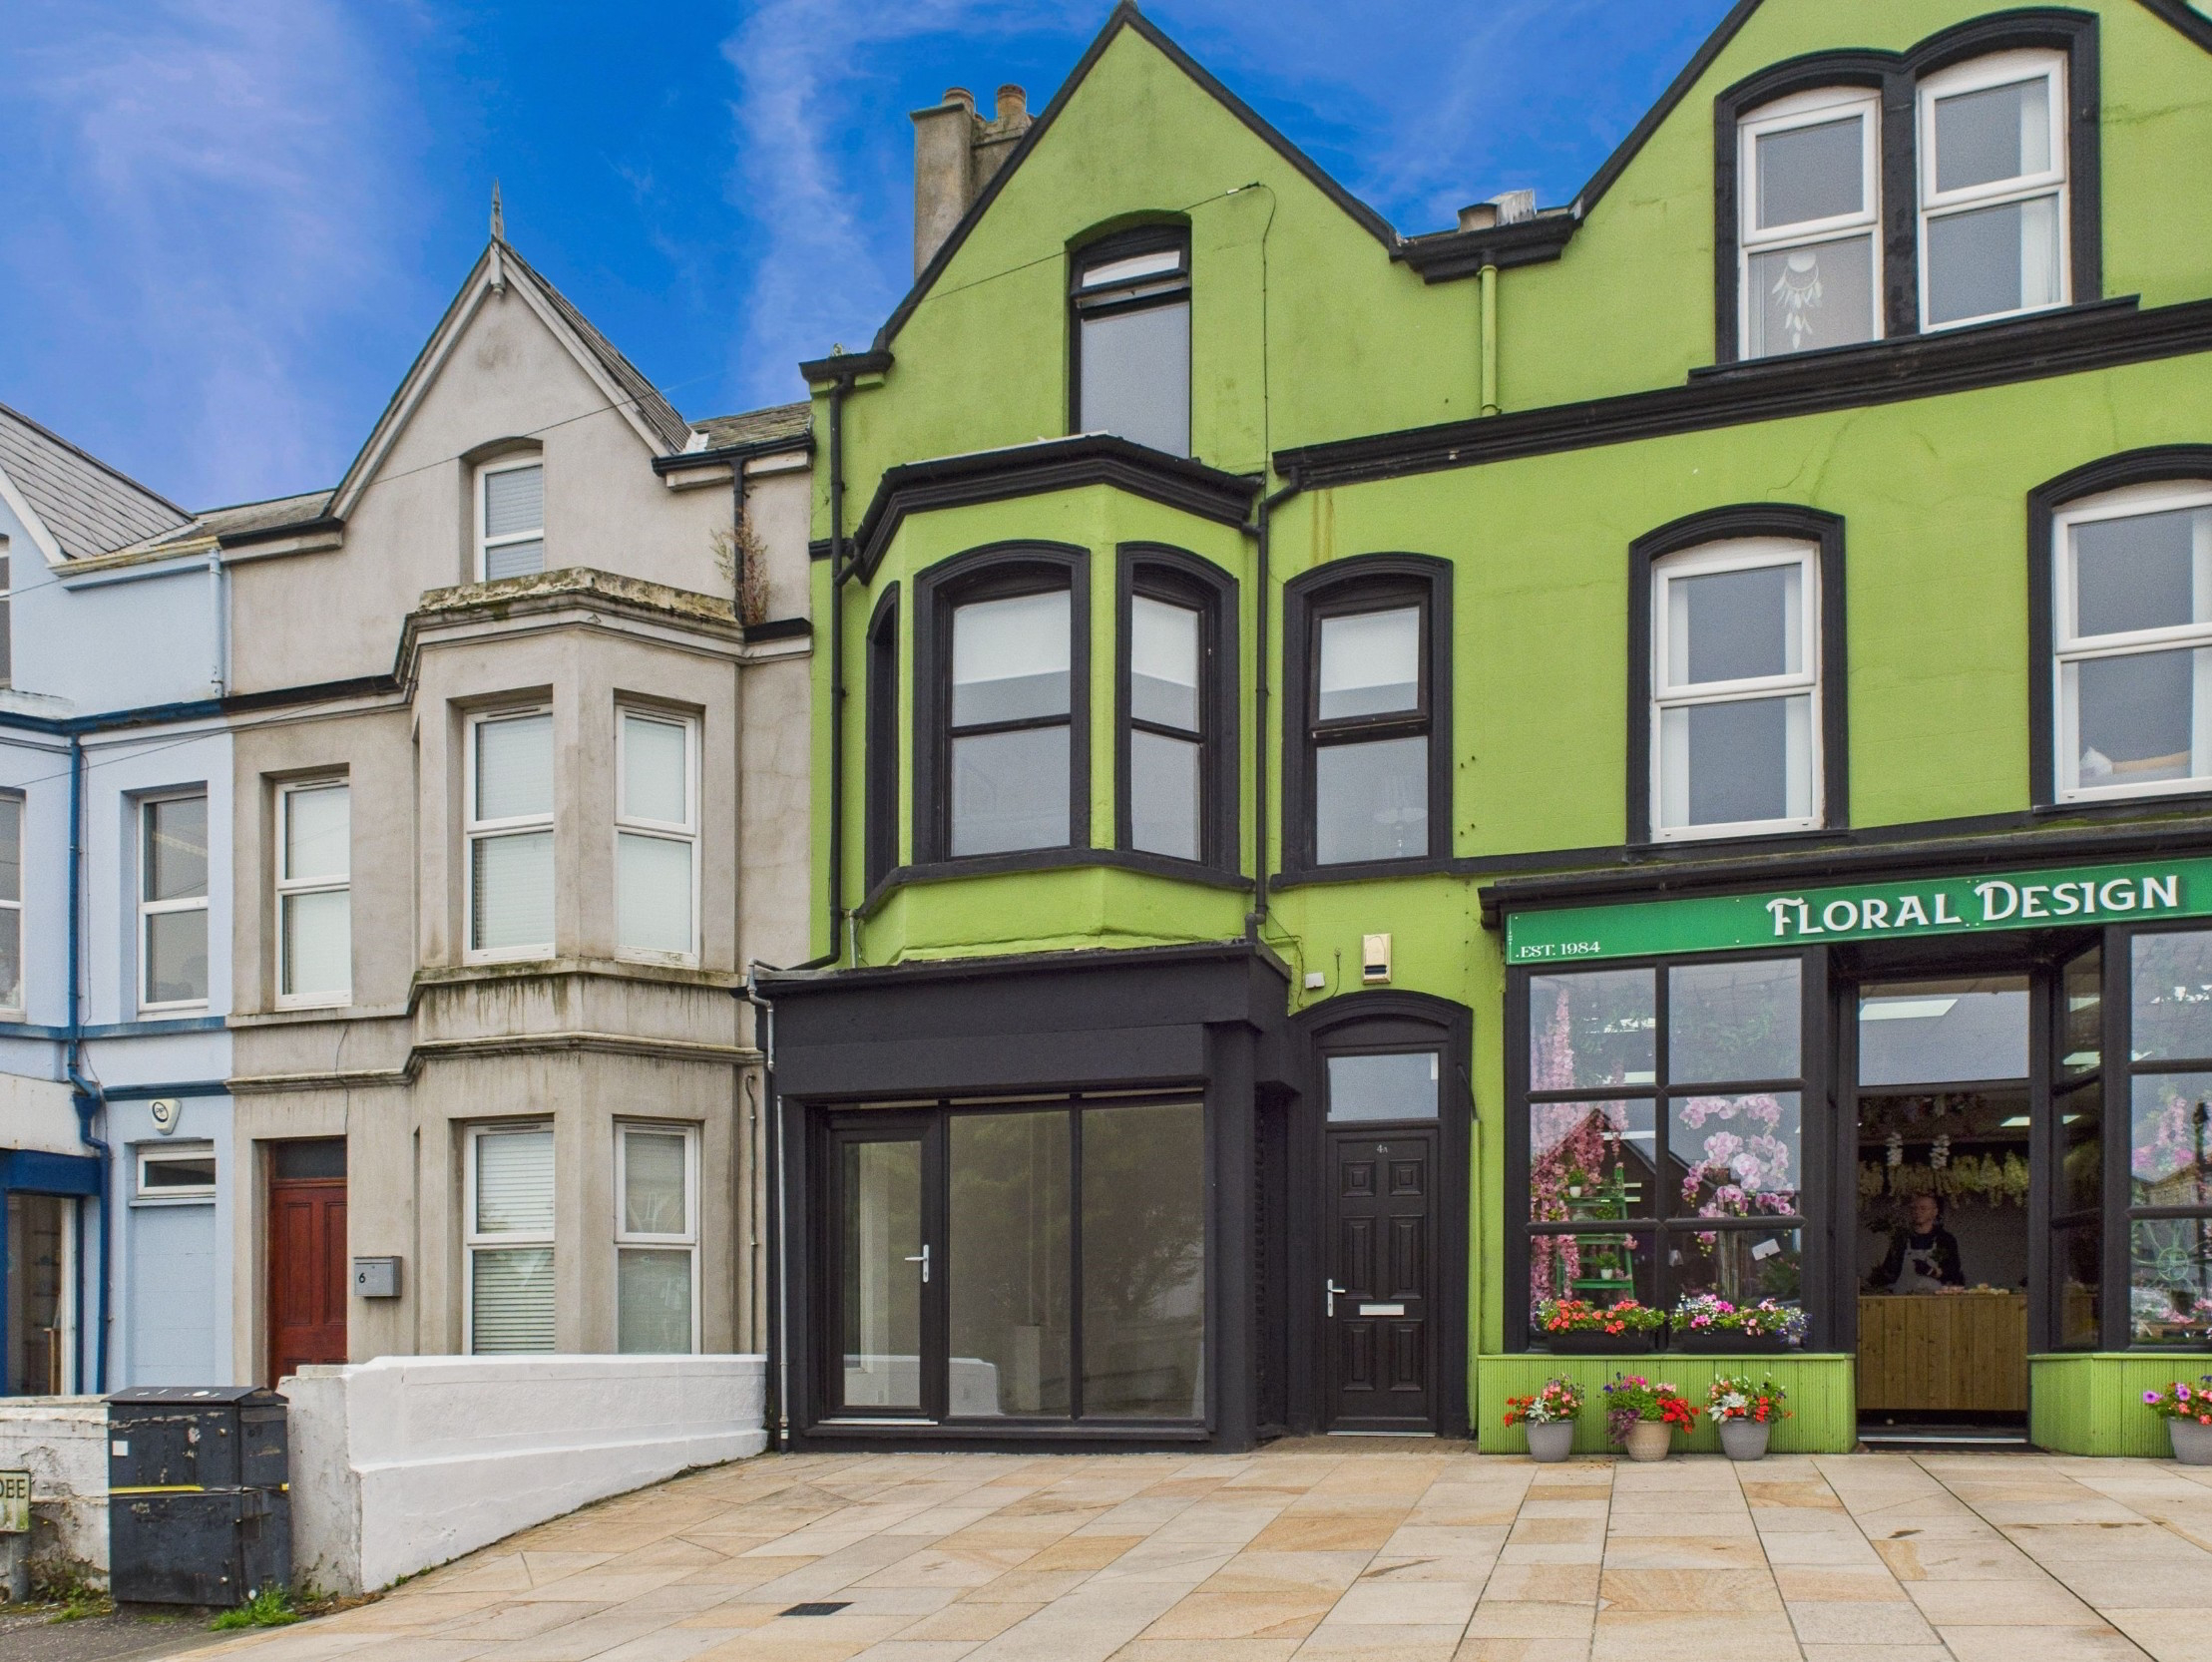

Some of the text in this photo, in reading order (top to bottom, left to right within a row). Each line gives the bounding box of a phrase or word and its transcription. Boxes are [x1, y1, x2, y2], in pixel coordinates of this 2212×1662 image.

[1765, 875, 2179, 936] FLORAL DESIGN
[1521, 941, 1601, 958] EST. 1984
[359, 1272, 366, 1284] 6
